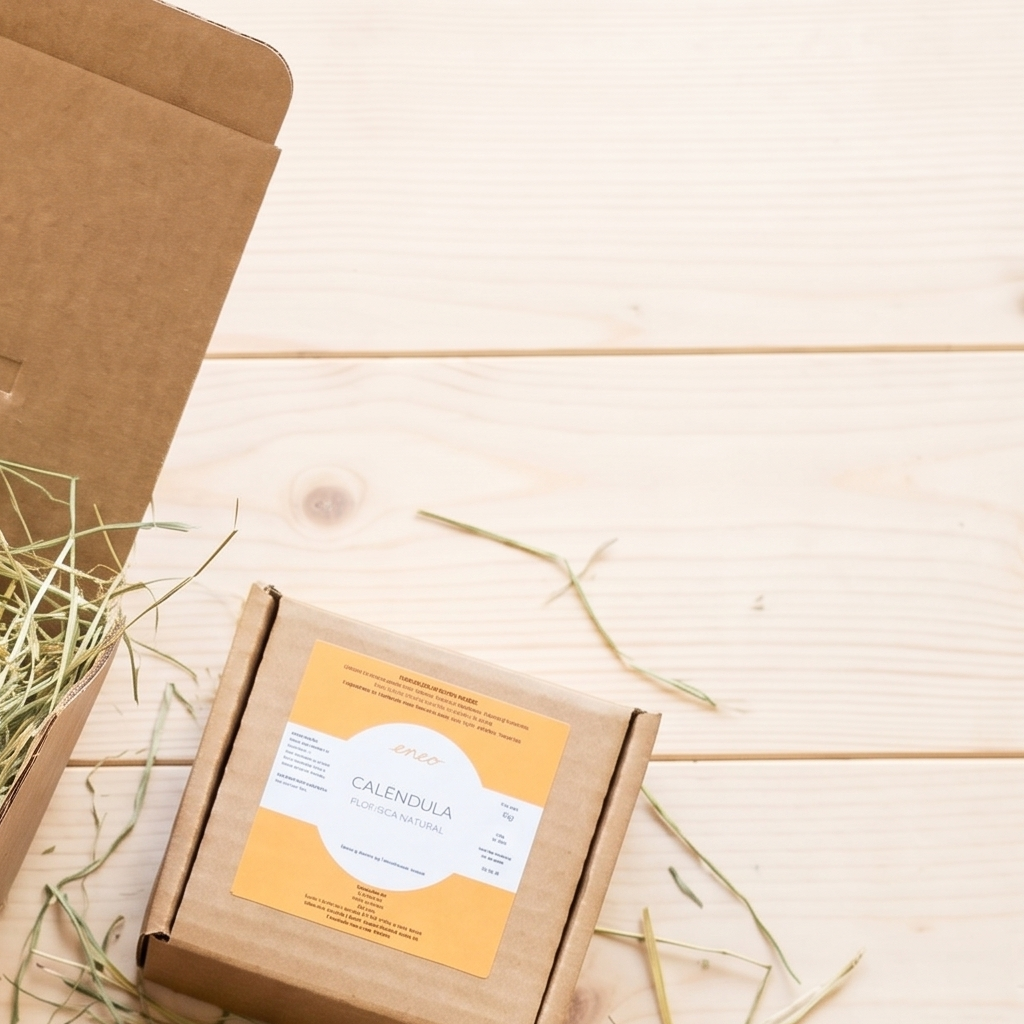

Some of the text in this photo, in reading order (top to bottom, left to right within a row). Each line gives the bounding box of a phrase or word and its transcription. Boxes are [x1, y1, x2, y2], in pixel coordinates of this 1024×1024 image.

[388, 744, 445, 766] eneo
[351, 776, 452, 820] CALENDULA
[399, 813, 444, 835] NATURAL
